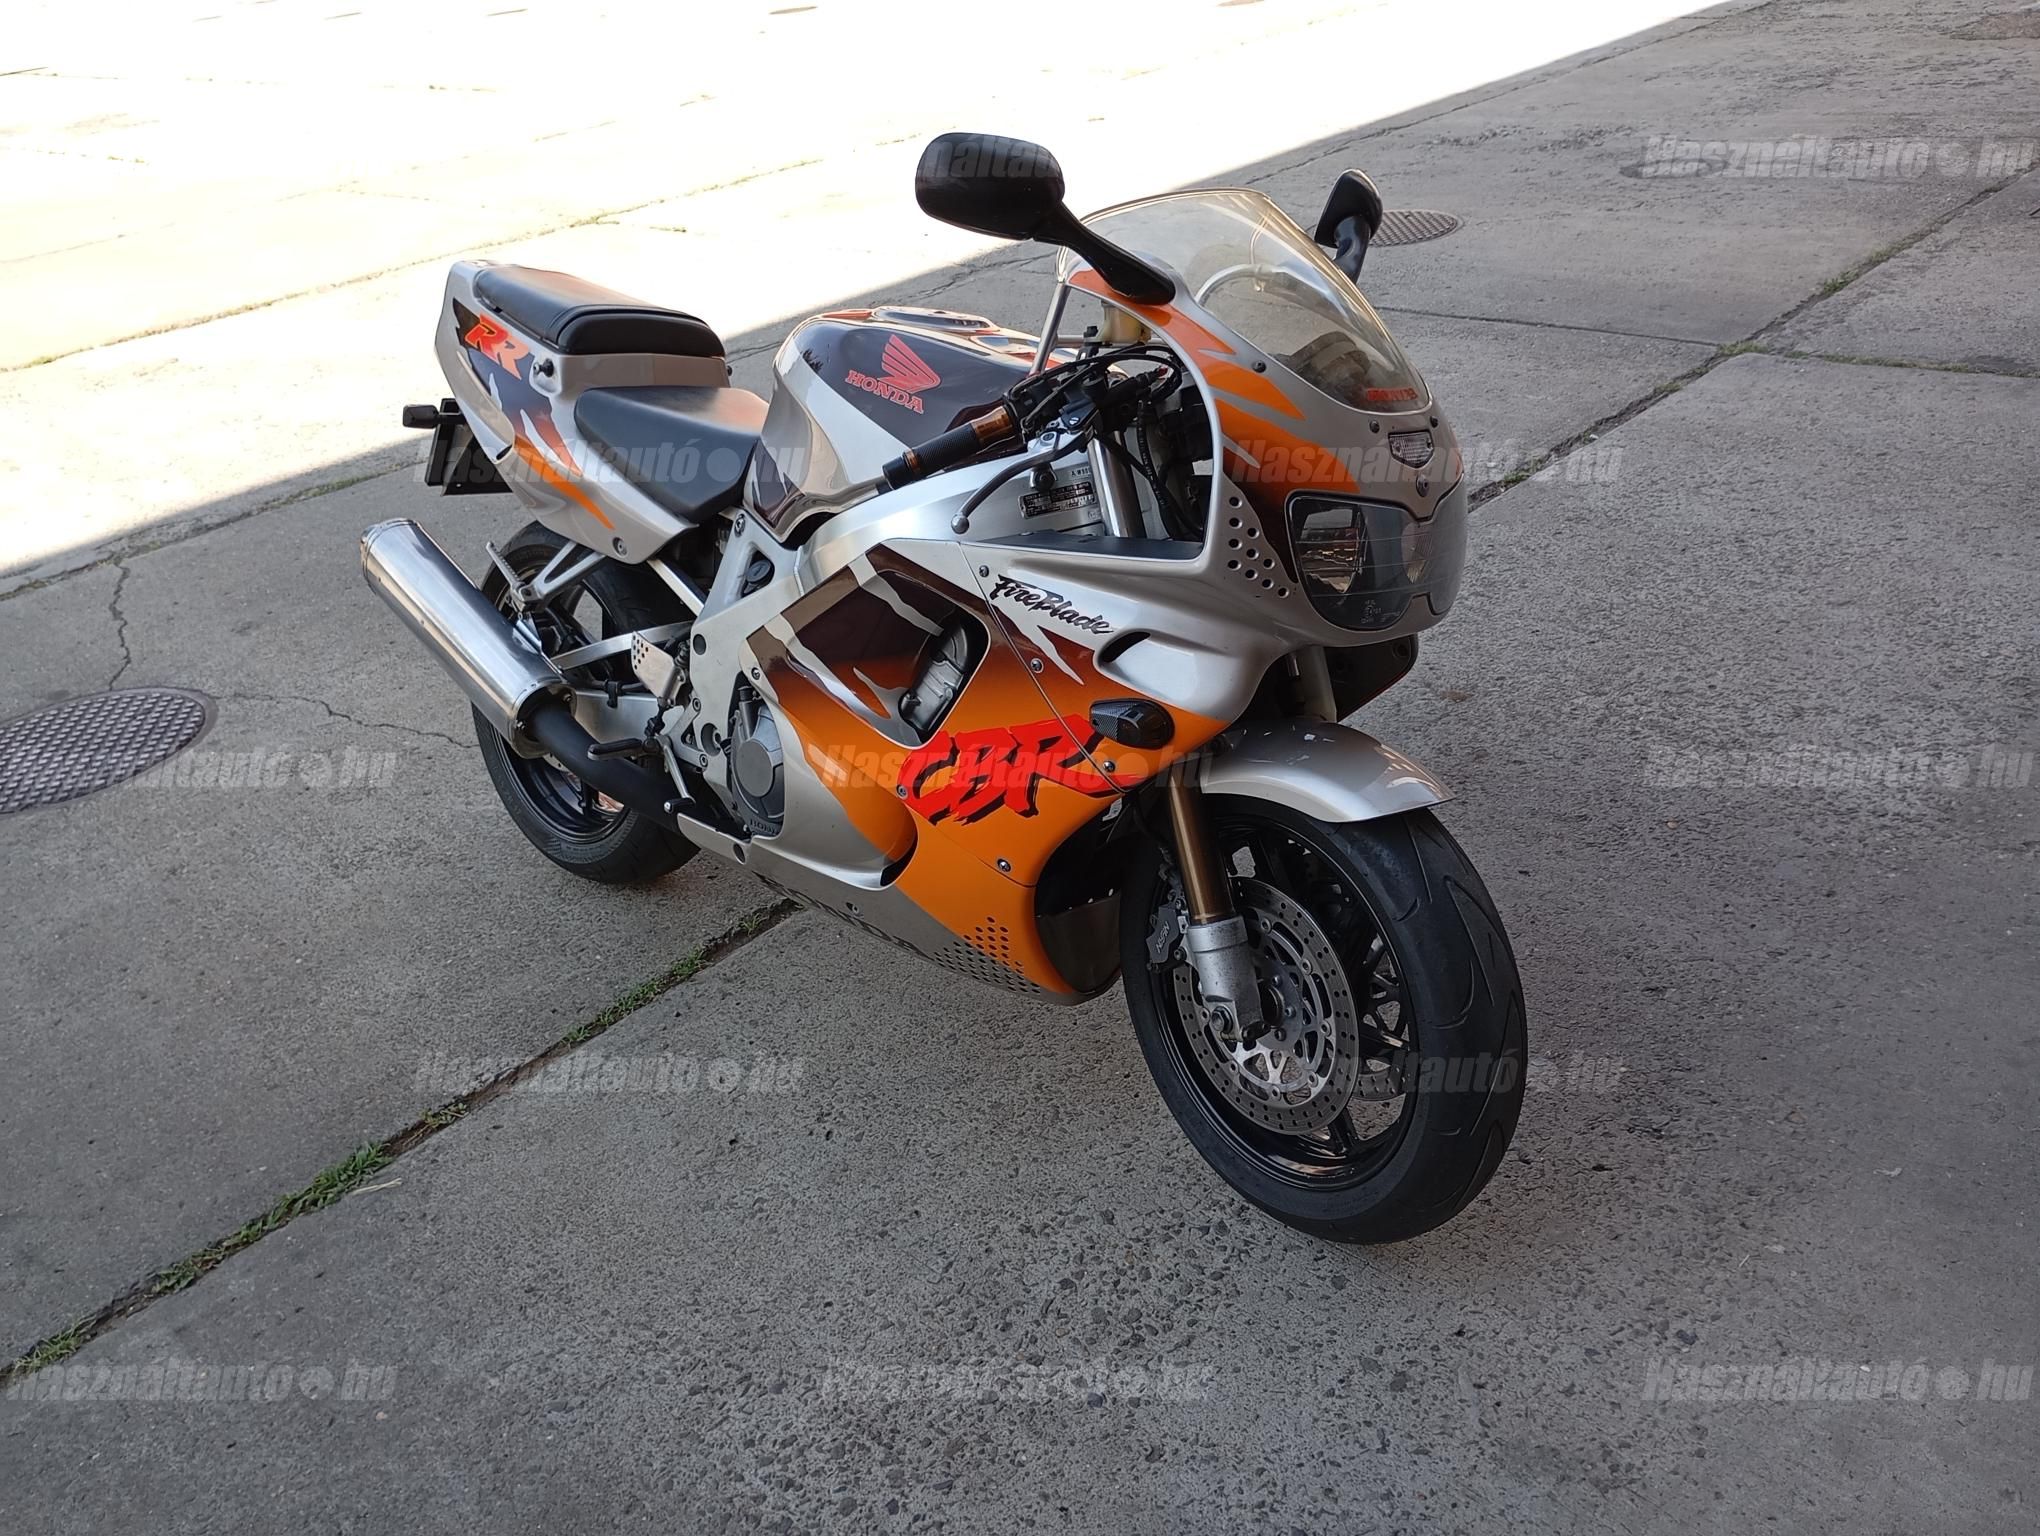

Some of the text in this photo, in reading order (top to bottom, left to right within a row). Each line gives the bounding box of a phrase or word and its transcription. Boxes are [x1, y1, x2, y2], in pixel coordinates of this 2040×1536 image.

[465, 312, 531, 381] RR
[845, 369, 924, 414] HONDA
[989, 574, 1114, 635] FireBlade
[897, 714, 1148, 826] CBR
